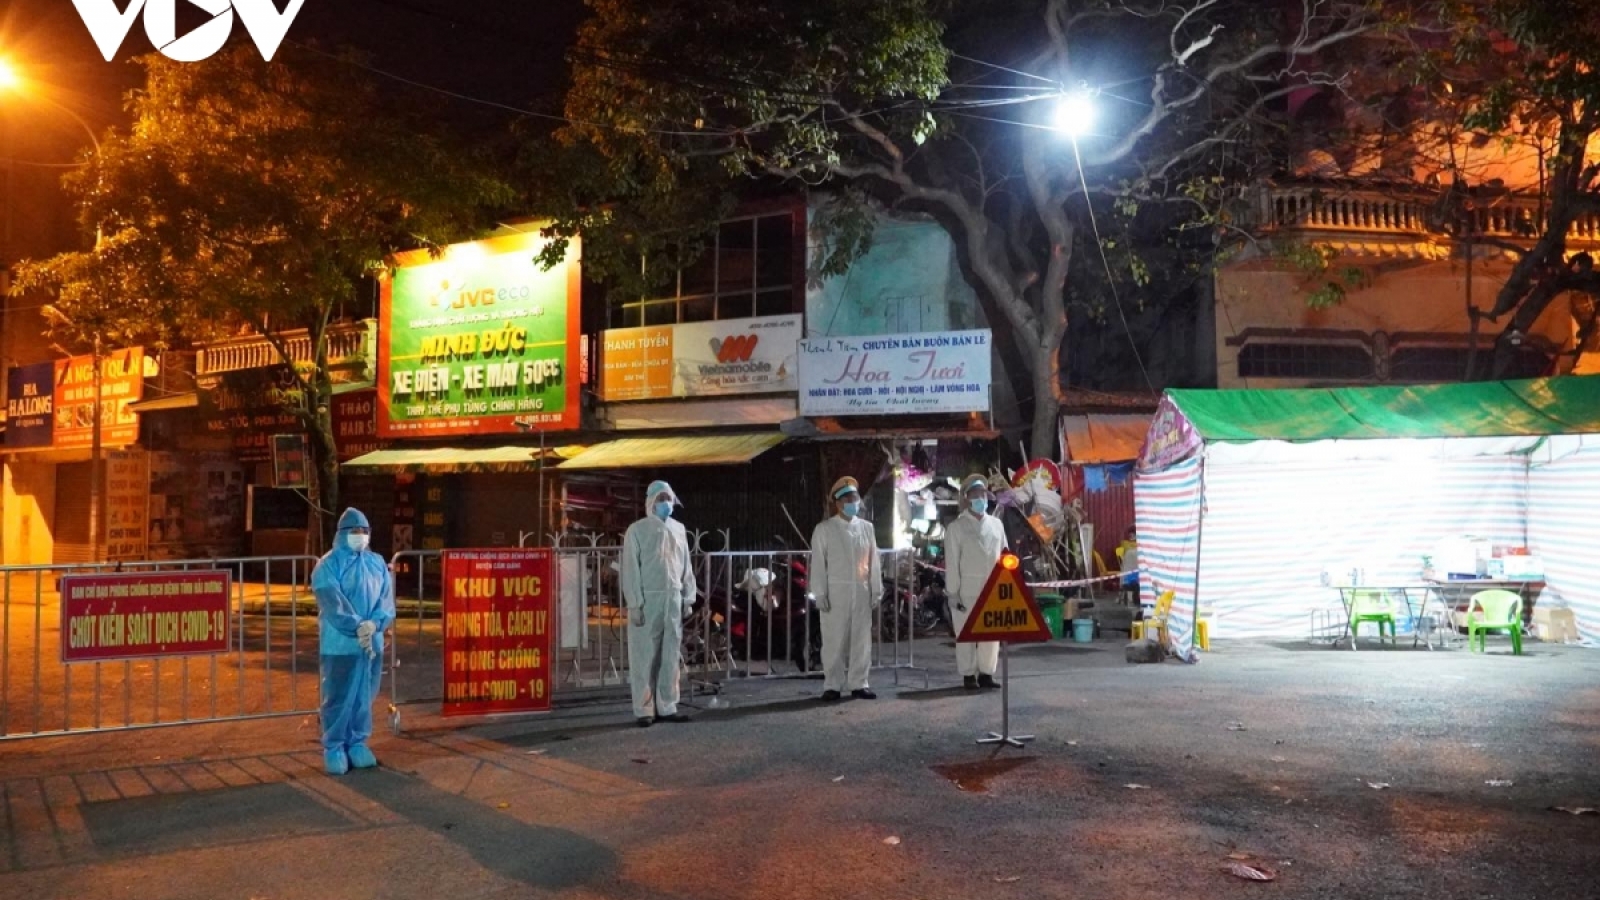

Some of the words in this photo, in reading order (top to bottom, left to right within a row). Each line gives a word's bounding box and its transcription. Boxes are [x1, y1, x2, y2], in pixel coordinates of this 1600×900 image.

[420, 333, 477, 357] MINH
[479, 320, 527, 352] ĐỨC
[862, 336, 900, 350] CHUYÊN
[902, 336, 922, 348] BÁN
[923, 336, 950, 347] BUÔN
[952, 335, 973, 347] BÁN
[392, 371, 413, 394] XE
[415, 364, 450, 396] ĐIỆN
[463, 365, 484, 389] XE
[486, 357, 520, 388] MÁY
[698, 360, 771, 375] Vietnamobile
[823, 352, 892, 384] Hoa
[903, 350, 967, 381] Tươi
[340, 397, 371, 416] THẢO
[407, 405, 425, 416] THAY
[463, 401, 488, 413] TÙNG
[491, 398, 516, 411] CHÍNH
[340, 420, 365, 436] HAIR
[454, 577, 497, 597] KHU
[502, 574, 541, 601] VỰC
[998, 583, 1013, 600] ĐI
[70, 603, 96, 649] CHỐT
[99, 600, 125, 647] KIỂM
[127, 605, 153, 645] SOÁT
[155, 611, 179, 651] DỊCH
[181, 610, 225, 643] COVID-19
[446, 611, 481, 638] PHONG
[507, 605, 533, 637] CÁCH
[535, 611, 547, 636] LY
[983, 607, 1028, 629] CHẬM
[452, 646, 496, 671] PHÒNG
[498, 642, 541, 669] CHỐNG
[447, 682, 477, 707] DỊCH
[481, 679, 517, 701] COVID
[529, 678, 544, 699] 19
